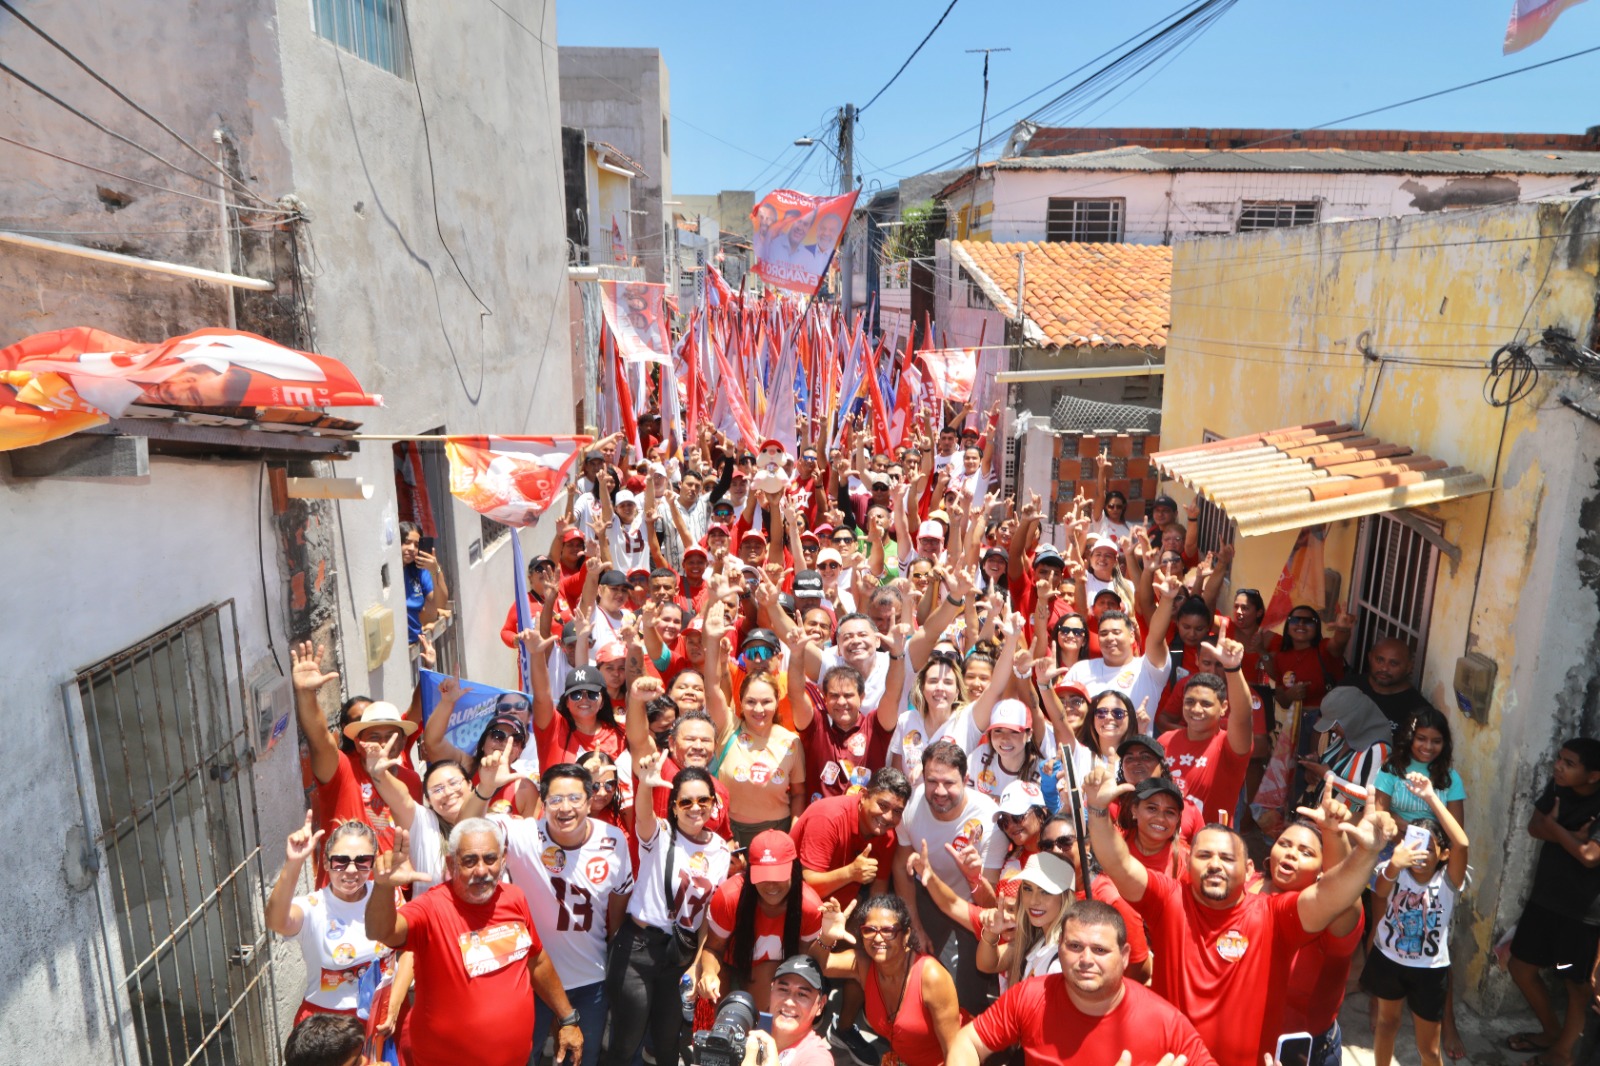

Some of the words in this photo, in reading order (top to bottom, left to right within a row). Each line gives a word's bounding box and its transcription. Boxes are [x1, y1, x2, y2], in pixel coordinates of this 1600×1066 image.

[587, 858, 607, 881] 13
[668, 868, 713, 927] 13
[550, 876, 594, 933] 13
